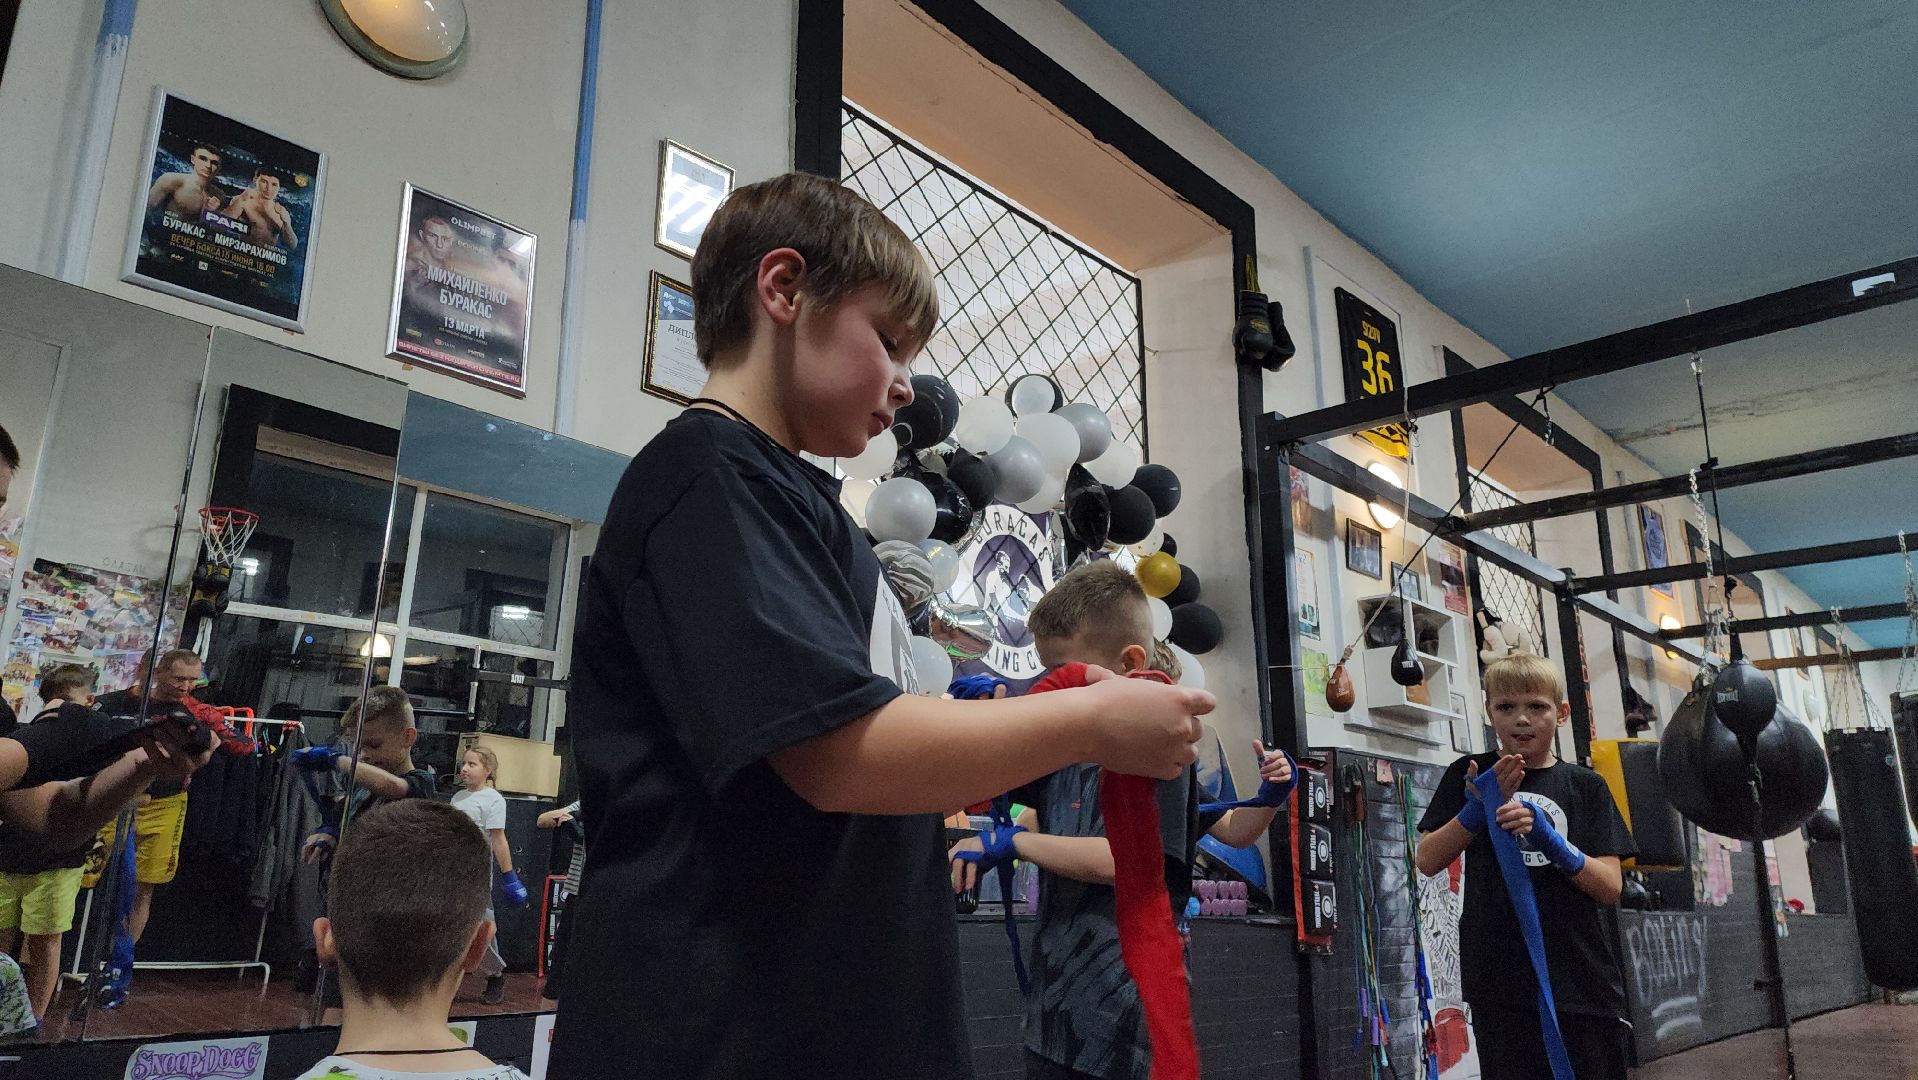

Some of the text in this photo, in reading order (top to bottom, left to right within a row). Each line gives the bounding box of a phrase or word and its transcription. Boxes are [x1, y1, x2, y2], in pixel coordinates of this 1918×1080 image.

[206, 212, 248, 233] PARI
[163, 216, 206, 239] БУРАКАС
[214, 233, 287, 265] МИРЗАРАХИМОВ
[171, 234, 196, 248] ВЕЧЕР
[196, 242, 220, 254] БОКСА
[231, 254, 254, 266] ИЮНЯ
[439, 288, 493, 319] БУРАКАС
[443, 316, 454, 329] 13
[455, 318, 485, 340] МАРТА
[667, 323, 697, 341] ДИПЛ
[1357, 339, 1394, 396] 36
[987, 647, 1020, 672] ING
[131, 1042, 262, 1080] SNOOP DOGG
